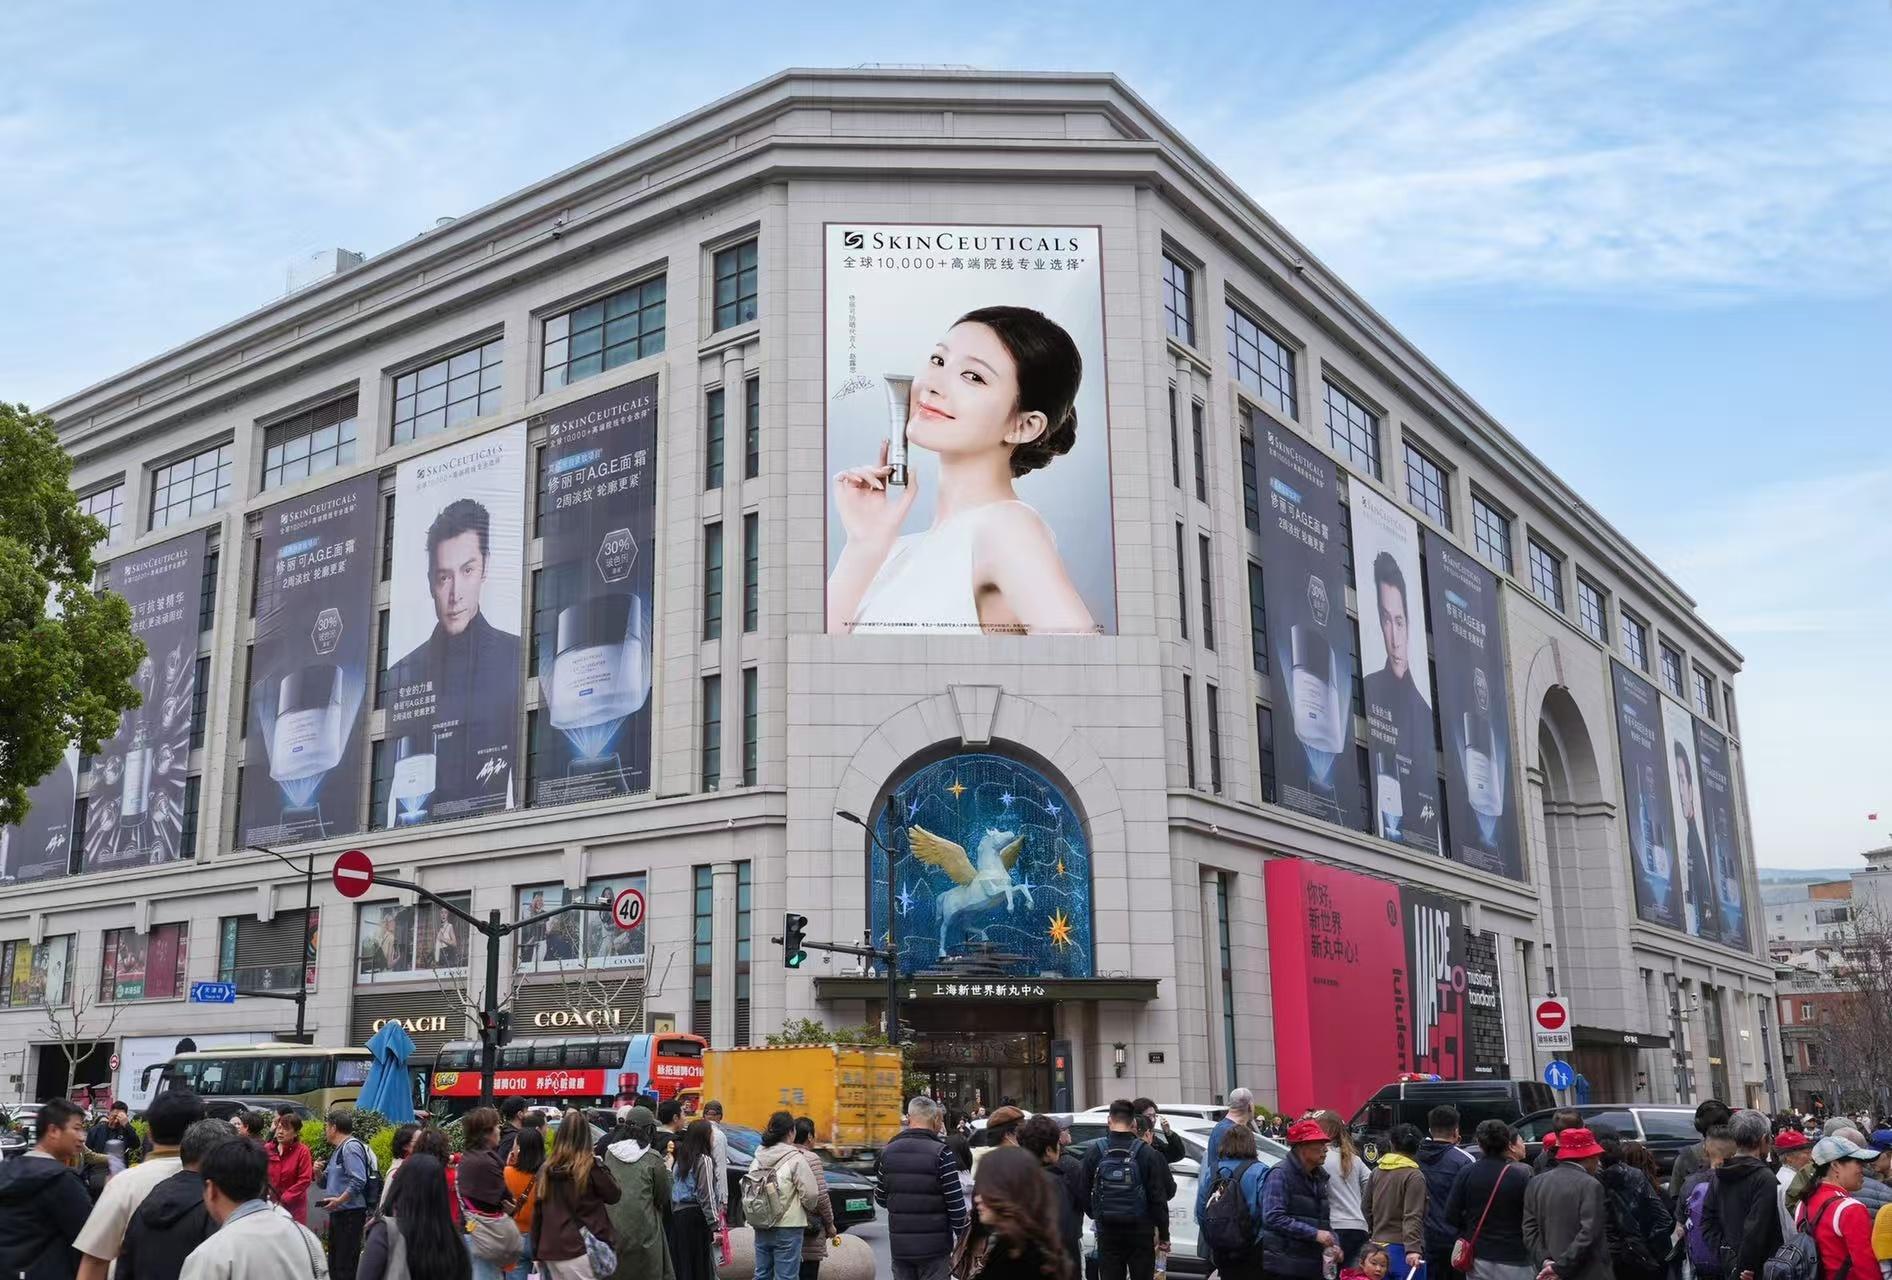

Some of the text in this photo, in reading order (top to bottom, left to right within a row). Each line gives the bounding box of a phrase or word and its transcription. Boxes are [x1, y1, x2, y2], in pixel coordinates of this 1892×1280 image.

[872, 232, 1079, 252] SKINCEUTICALS
[561, 396, 650, 433] SKINCEUTICALS
[604, 537, 630, 556] 30%
[620, 899, 639, 920] 40
[1309, 907, 1342, 935] 新世界
[933, 983, 1045, 996] 上海新世界新丸中心
[372, 1016, 446, 1033] CACH
[534, 1009, 621, 1028] COACH
